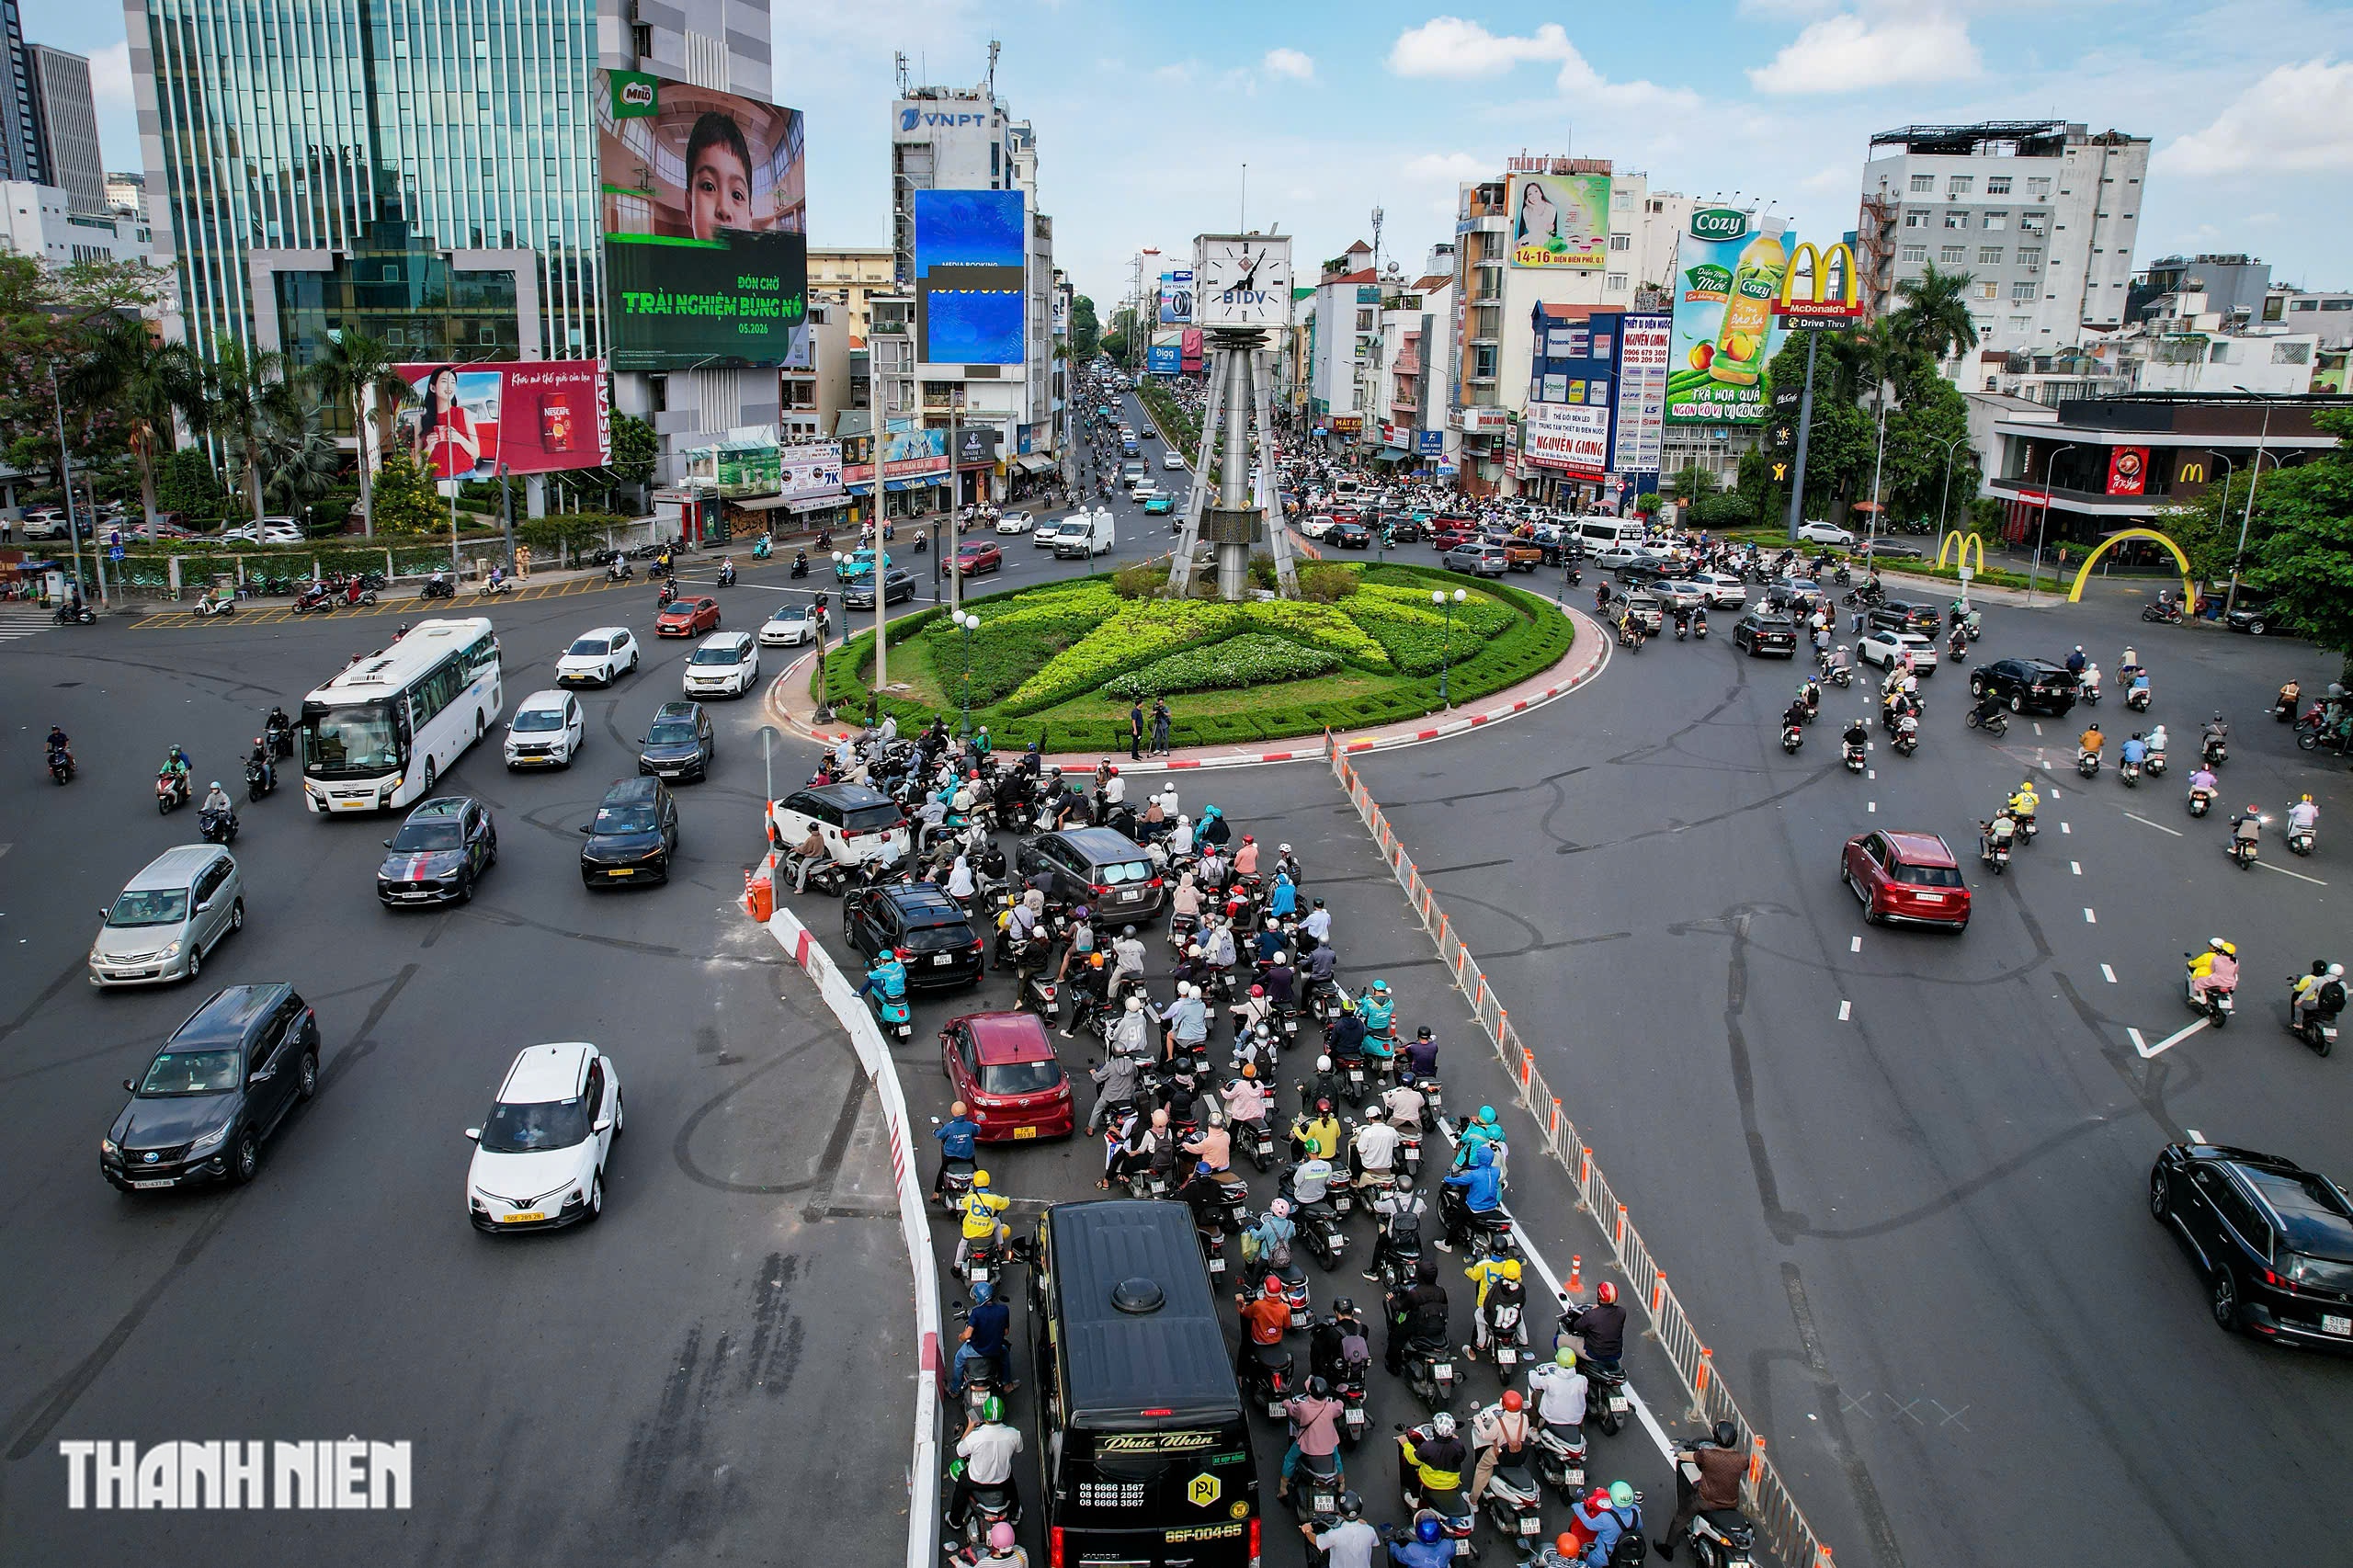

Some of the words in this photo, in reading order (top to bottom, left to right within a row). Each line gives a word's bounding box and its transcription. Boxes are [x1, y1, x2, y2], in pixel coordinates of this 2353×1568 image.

[626, 88, 651, 101] MILO
[924, 113, 985, 126] VNPT
[1696, 214, 1742, 235] Cozy
[1516, 250, 1551, 263] 14-16
[738, 274, 759, 290] ĐÓN
[759, 276, 779, 291] CHỜ
[1696, 277, 1728, 290] Mới
[1742, 281, 1770, 299] Cozy
[1223, 290, 1266, 304] BIDV
[621, 287, 673, 314] TRẢI
[676, 290, 736, 321] NGHIỆM
[739, 292, 780, 317] BÙNG
[782, 292, 803, 318] NỔ
[1790, 304, 1846, 314] McDonald's
[738, 324, 768, 335] 05.2026
[1801, 319, 1824, 328] Drive
[1827, 320, 1846, 329] Thru
[1649, 334, 1668, 347] GIANG
[1692, 386, 1712, 402] TRÀ
[1715, 389, 1735, 402] HOA
[1739, 384, 1761, 402] QUẢ
[1673, 404, 1696, 416] NGON
[1536, 432, 1574, 453] NGUYỄN
[1574, 439, 1604, 457] GIANG
[830, 447, 841, 457] 7K
[824, 472, 839, 484] 7K
[1104, 1435, 1155, 1451] Phúc
[1094, 1483, 1119, 1492] 6666
[1120, 1483, 1145, 1491] 1567
[1094, 1491, 1119, 1499] 6666
[1120, 1490, 1145, 1498] 2567
[1094, 1499, 1119, 1507] 6666
[1120, 1498, 1145, 1506] 3567
